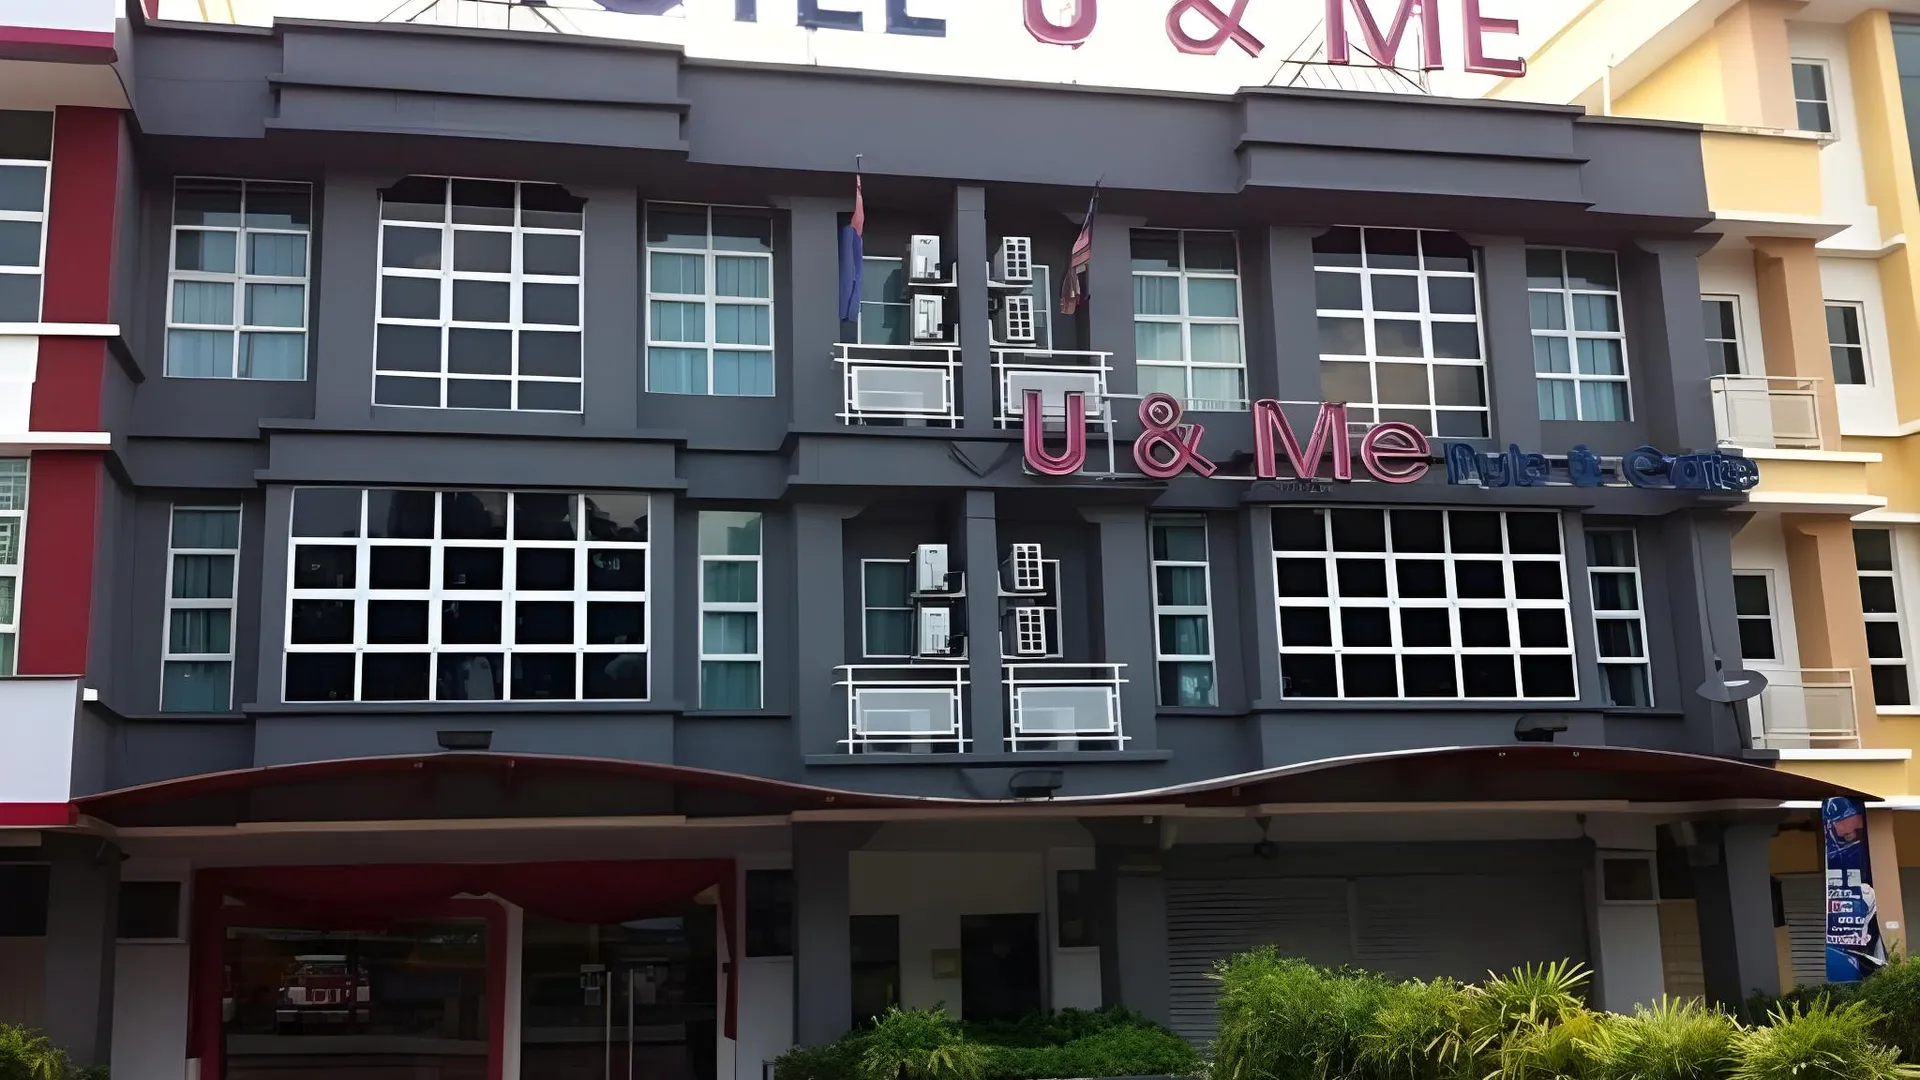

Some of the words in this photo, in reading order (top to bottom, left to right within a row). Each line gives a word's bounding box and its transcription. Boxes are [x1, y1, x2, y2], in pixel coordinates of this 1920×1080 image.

[1325, 0, 1527, 77] ME
[1022, 389, 1087, 476] U
[1133, 392, 1218, 479] &
[1254, 398, 1432, 484] Me
